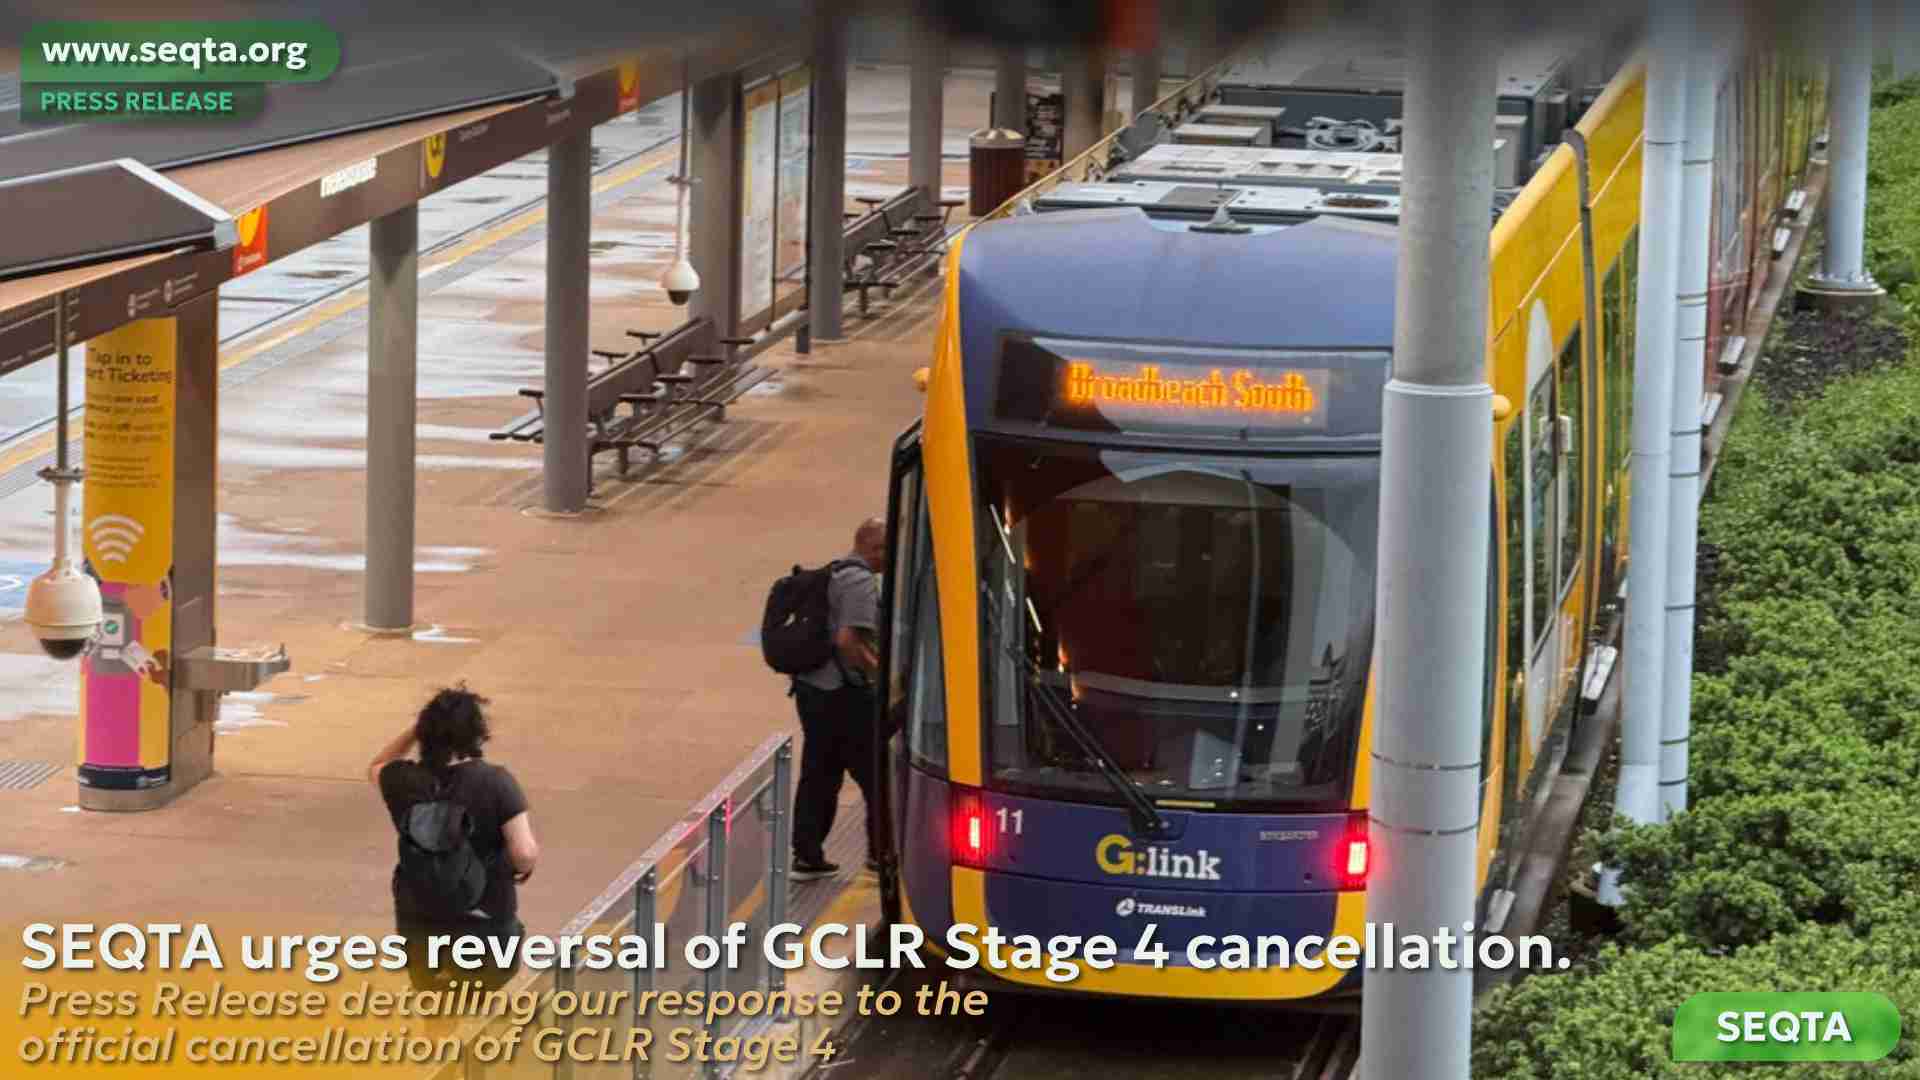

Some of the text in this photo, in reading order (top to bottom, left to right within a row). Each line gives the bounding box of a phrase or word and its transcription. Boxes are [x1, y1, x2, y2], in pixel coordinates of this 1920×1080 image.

[135, 353, 152, 366] to
[1068, 361, 1313, 411] Broadbeach South
[996, 808, 1024, 835] 11
[1095, 834, 1221, 881] G:link
